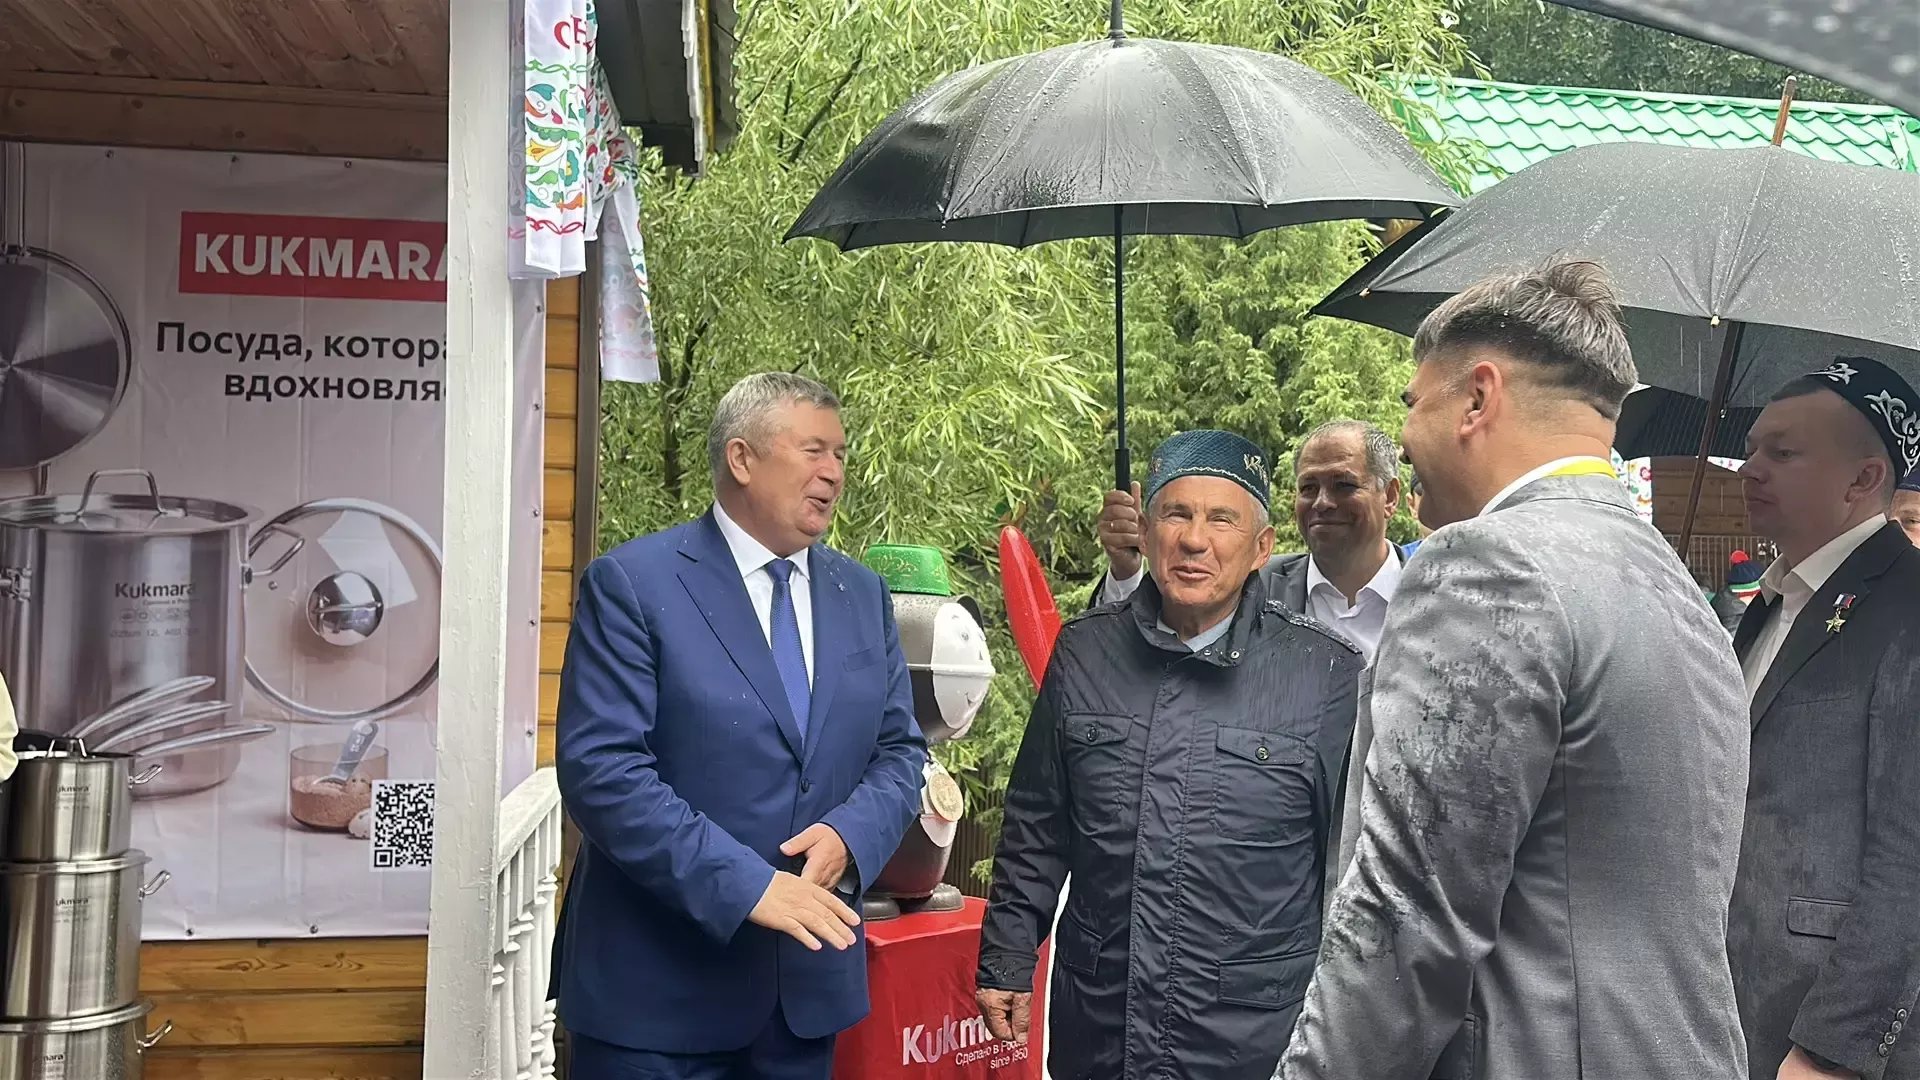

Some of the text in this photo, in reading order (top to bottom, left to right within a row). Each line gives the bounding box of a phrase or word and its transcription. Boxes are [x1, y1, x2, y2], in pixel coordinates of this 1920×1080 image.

[156, 322, 312, 363] Посуда,
[224, 373, 447, 402] вдохновля
[115, 583, 196, 599] Kukmara
[902, 1014, 995, 1066] Kukm
[955, 1046, 992, 1067] Сделано
[990, 1046, 1028, 1069] since 1950
